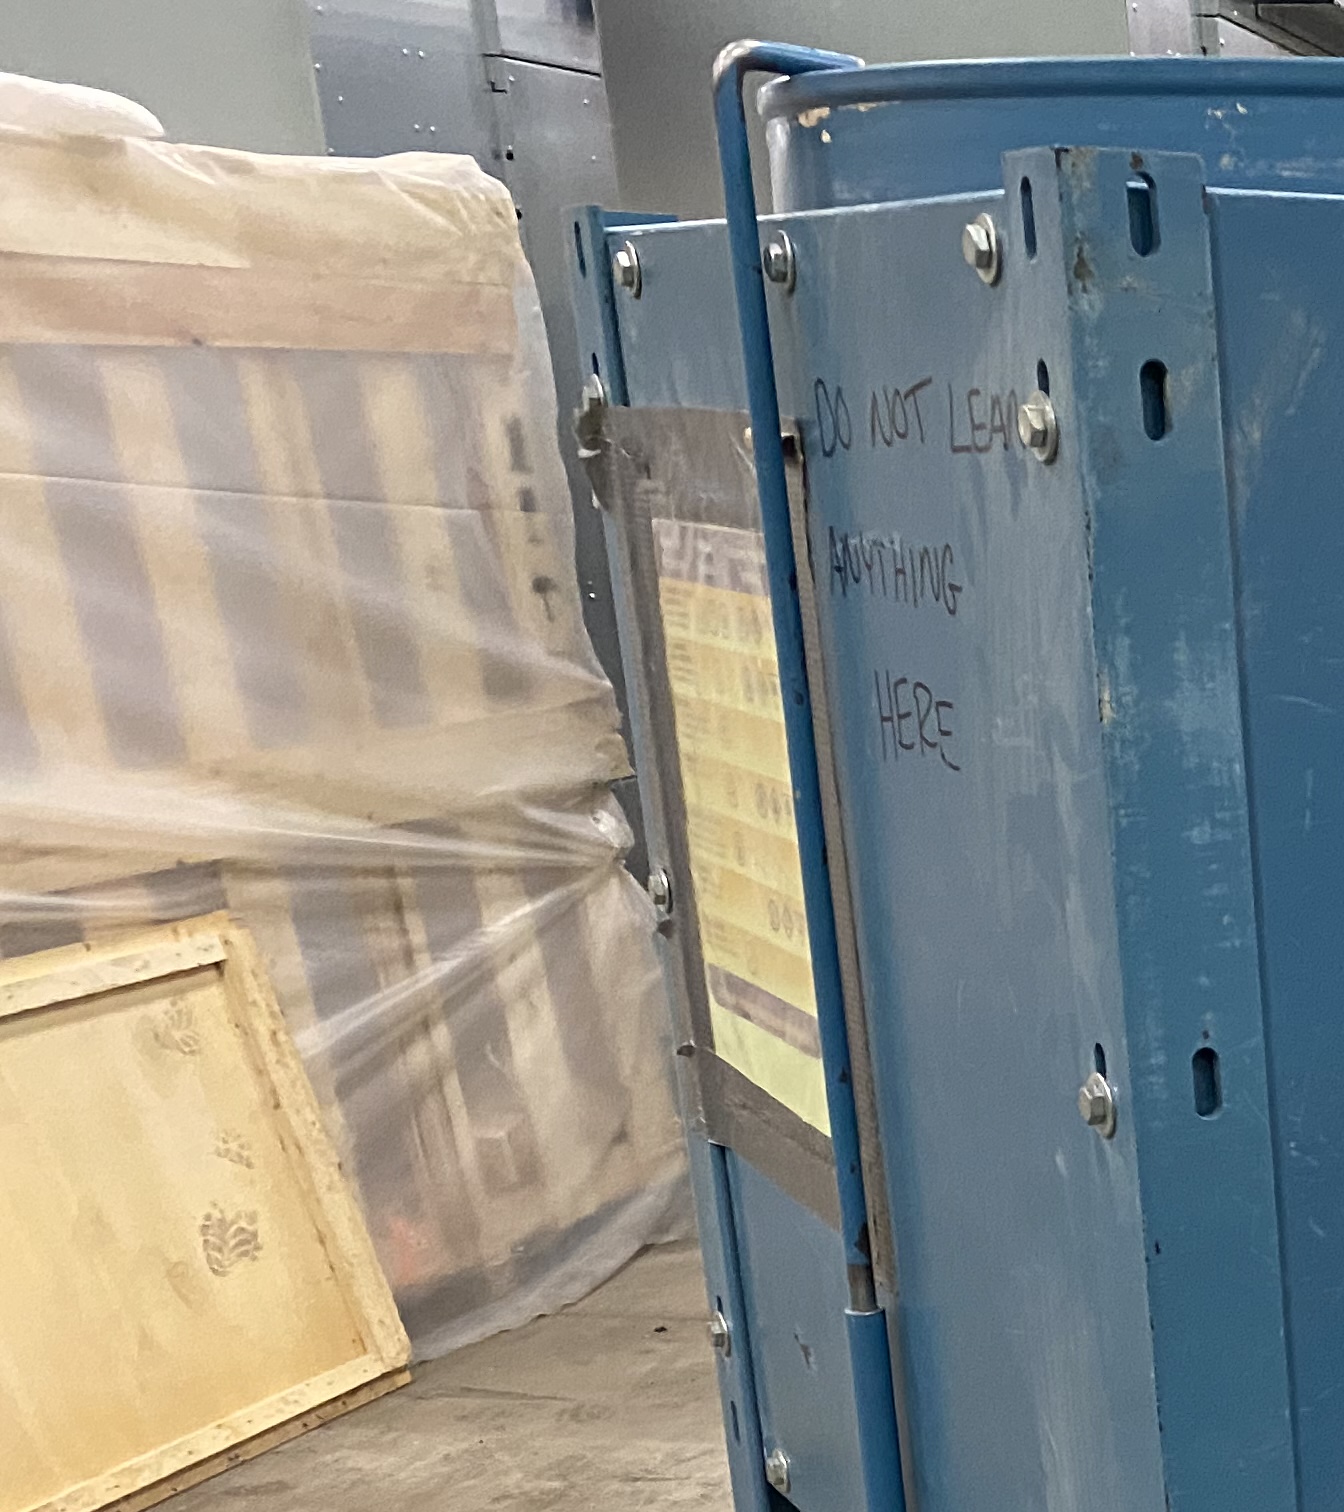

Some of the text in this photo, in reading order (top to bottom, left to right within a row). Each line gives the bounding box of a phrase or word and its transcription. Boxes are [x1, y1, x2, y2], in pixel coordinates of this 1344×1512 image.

[814, 378, 851, 457] DO
[870, 377, 932, 447] NOT
[829, 526, 963, 616] ANYTHING
[874, 669, 961, 771] HERE
